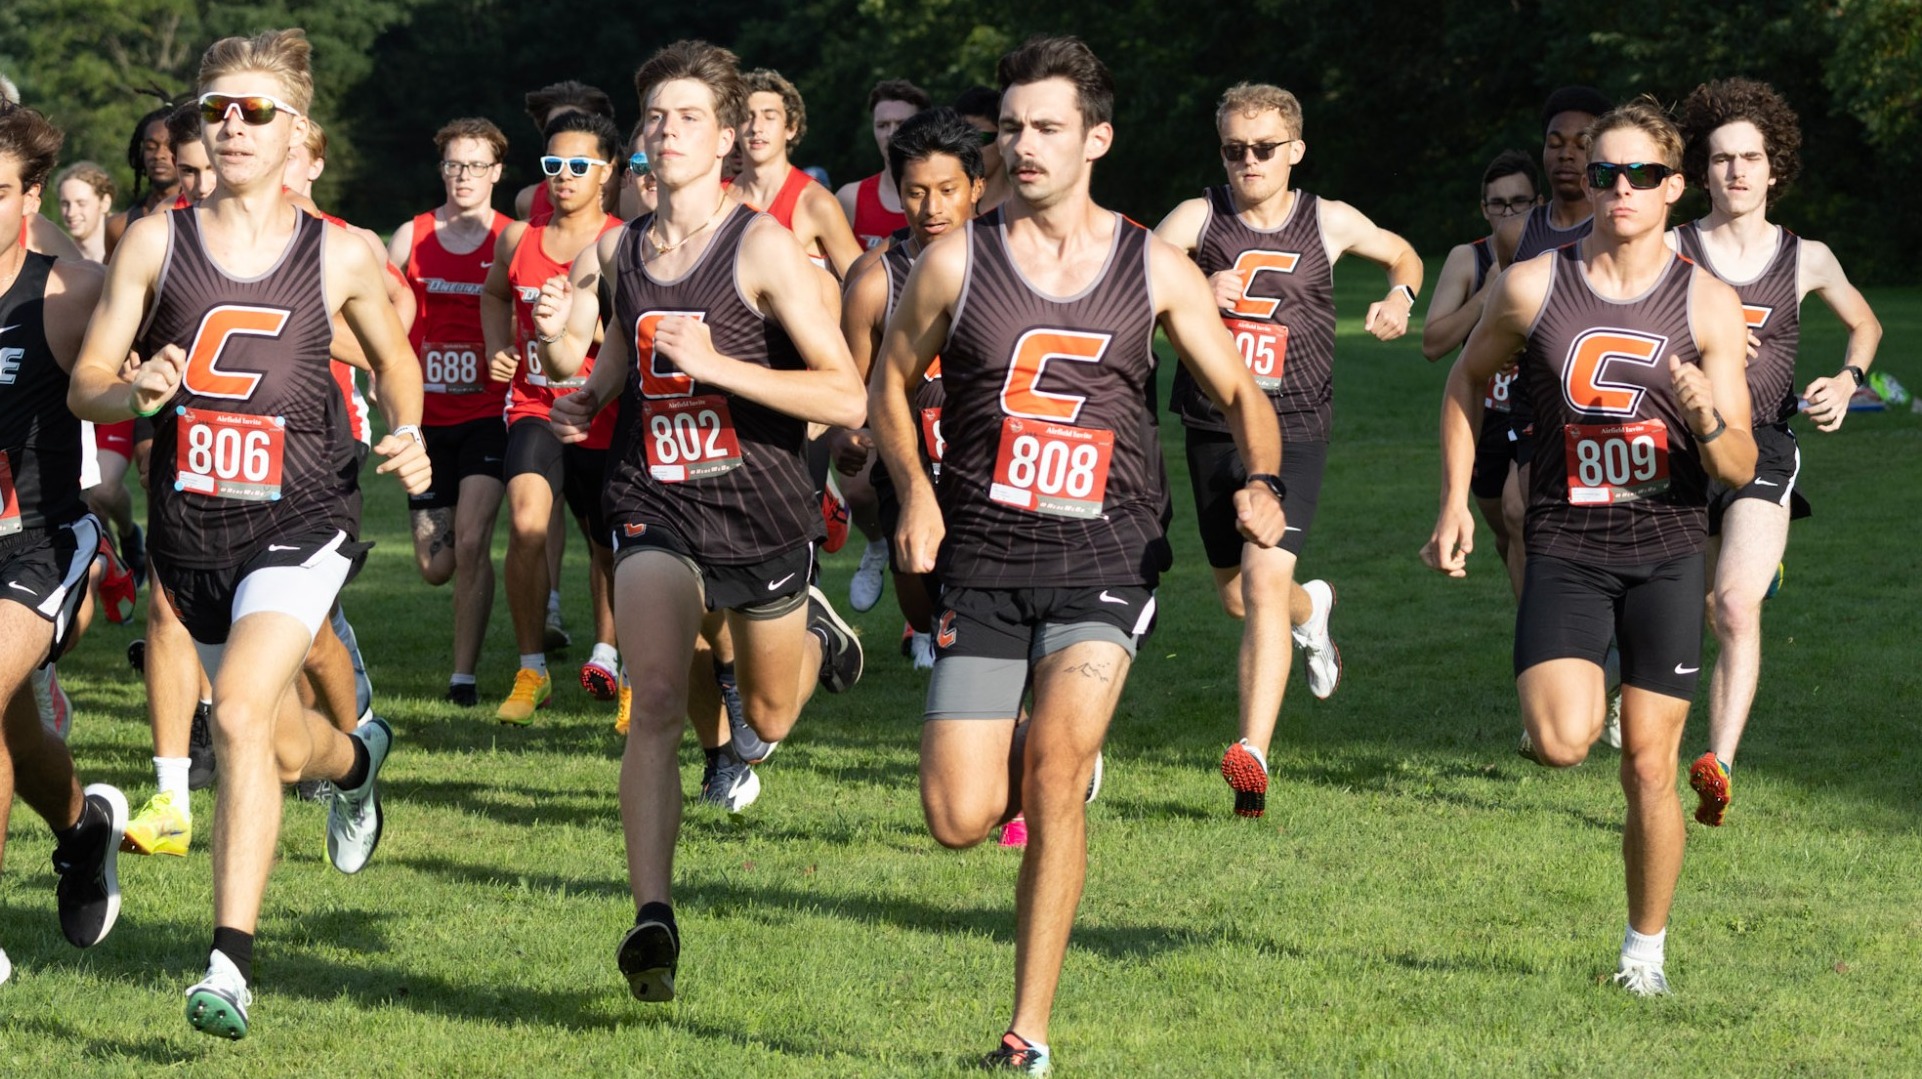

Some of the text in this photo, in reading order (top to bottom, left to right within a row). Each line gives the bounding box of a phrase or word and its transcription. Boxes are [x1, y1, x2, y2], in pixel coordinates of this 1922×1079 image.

[1227, 250, 1301, 318] C
[182, 305, 291, 400] C
[426, 350, 477, 383] 688
[1000, 328, 1113, 423] C
[1227, 329, 1277, 375] 05
[1561, 326, 1668, 418] C
[188, 423, 271, 482] 806
[651, 409, 728, 464] 802
[1008, 435, 1098, 498] 808
[1577, 435, 1657, 487] 809
